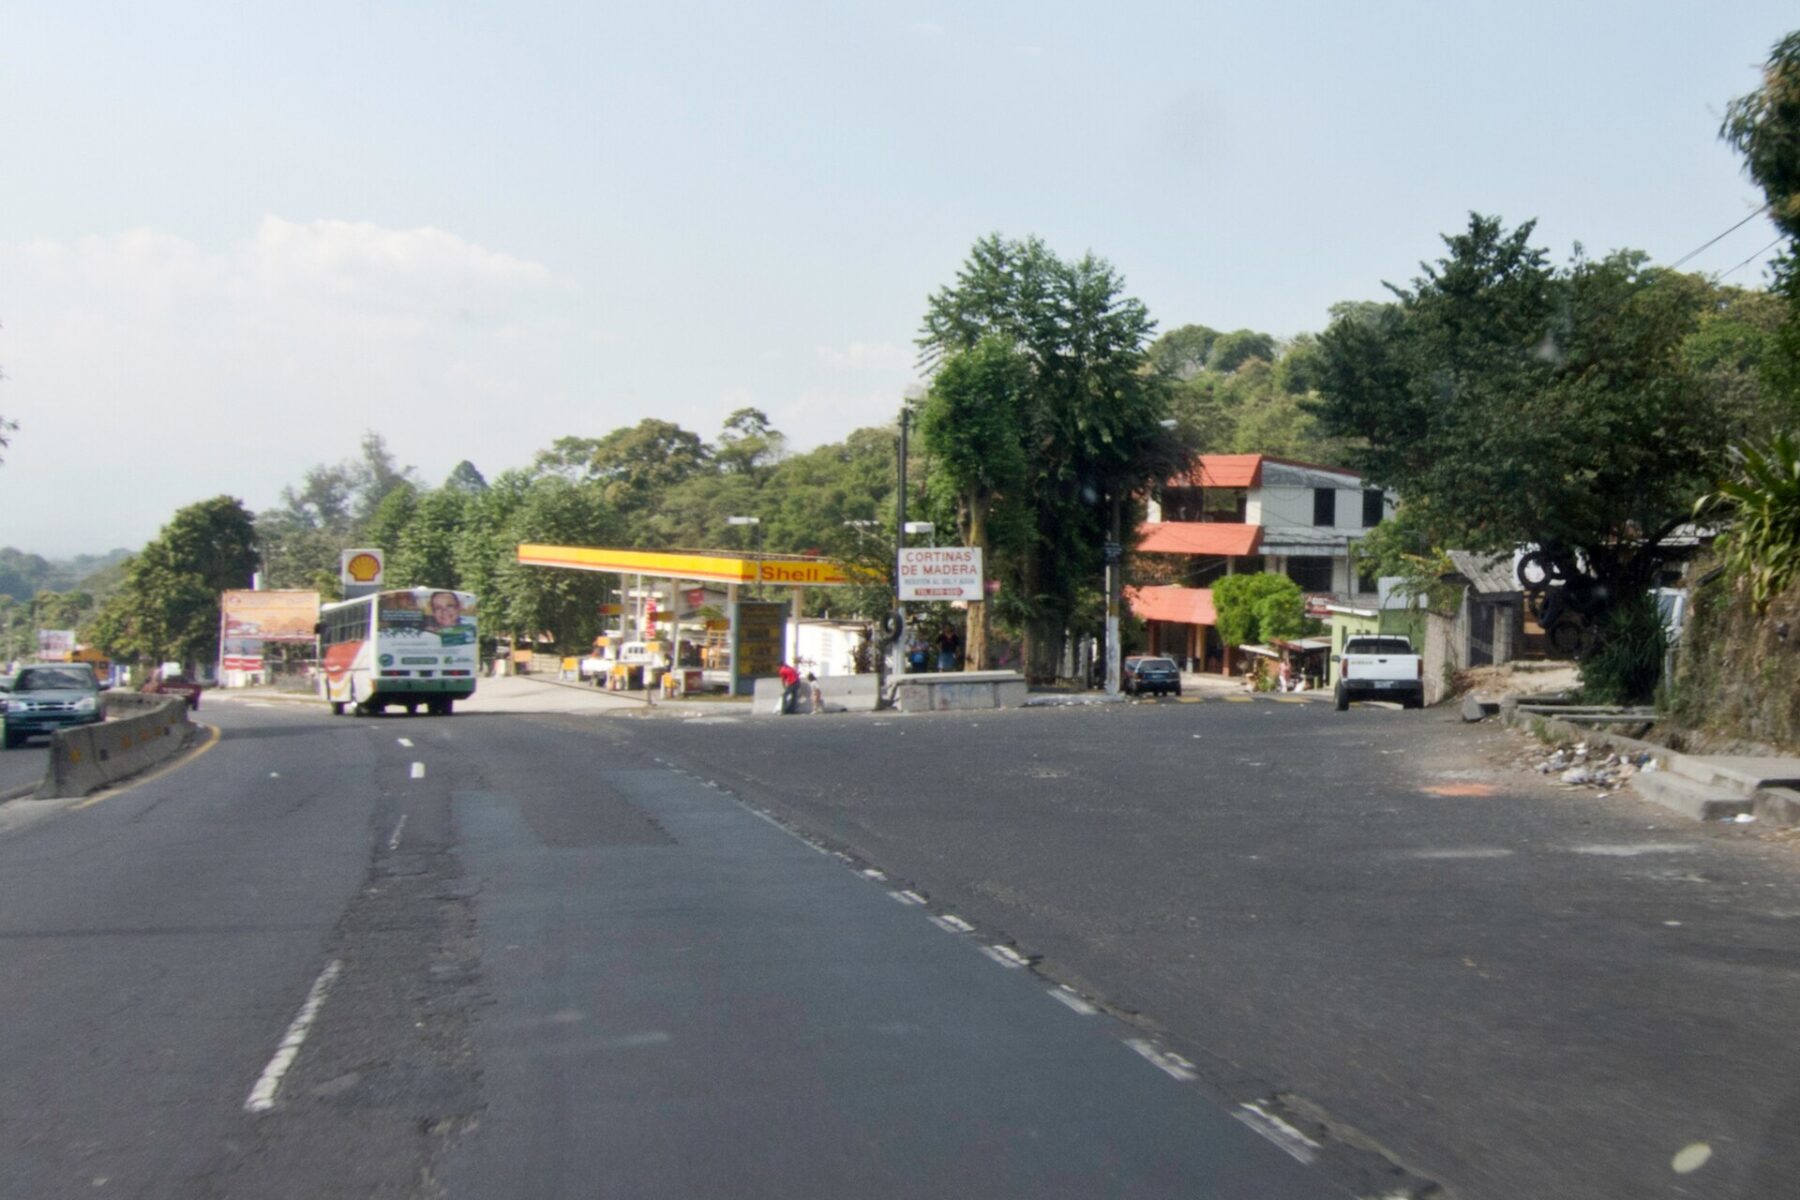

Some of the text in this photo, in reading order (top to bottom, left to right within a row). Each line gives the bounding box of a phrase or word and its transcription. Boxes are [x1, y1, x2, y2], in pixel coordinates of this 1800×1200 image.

[906, 551, 972, 562] CORTINAS
[761, 566, 819, 581] Shell
[901, 564, 977, 576] DE MADERA
